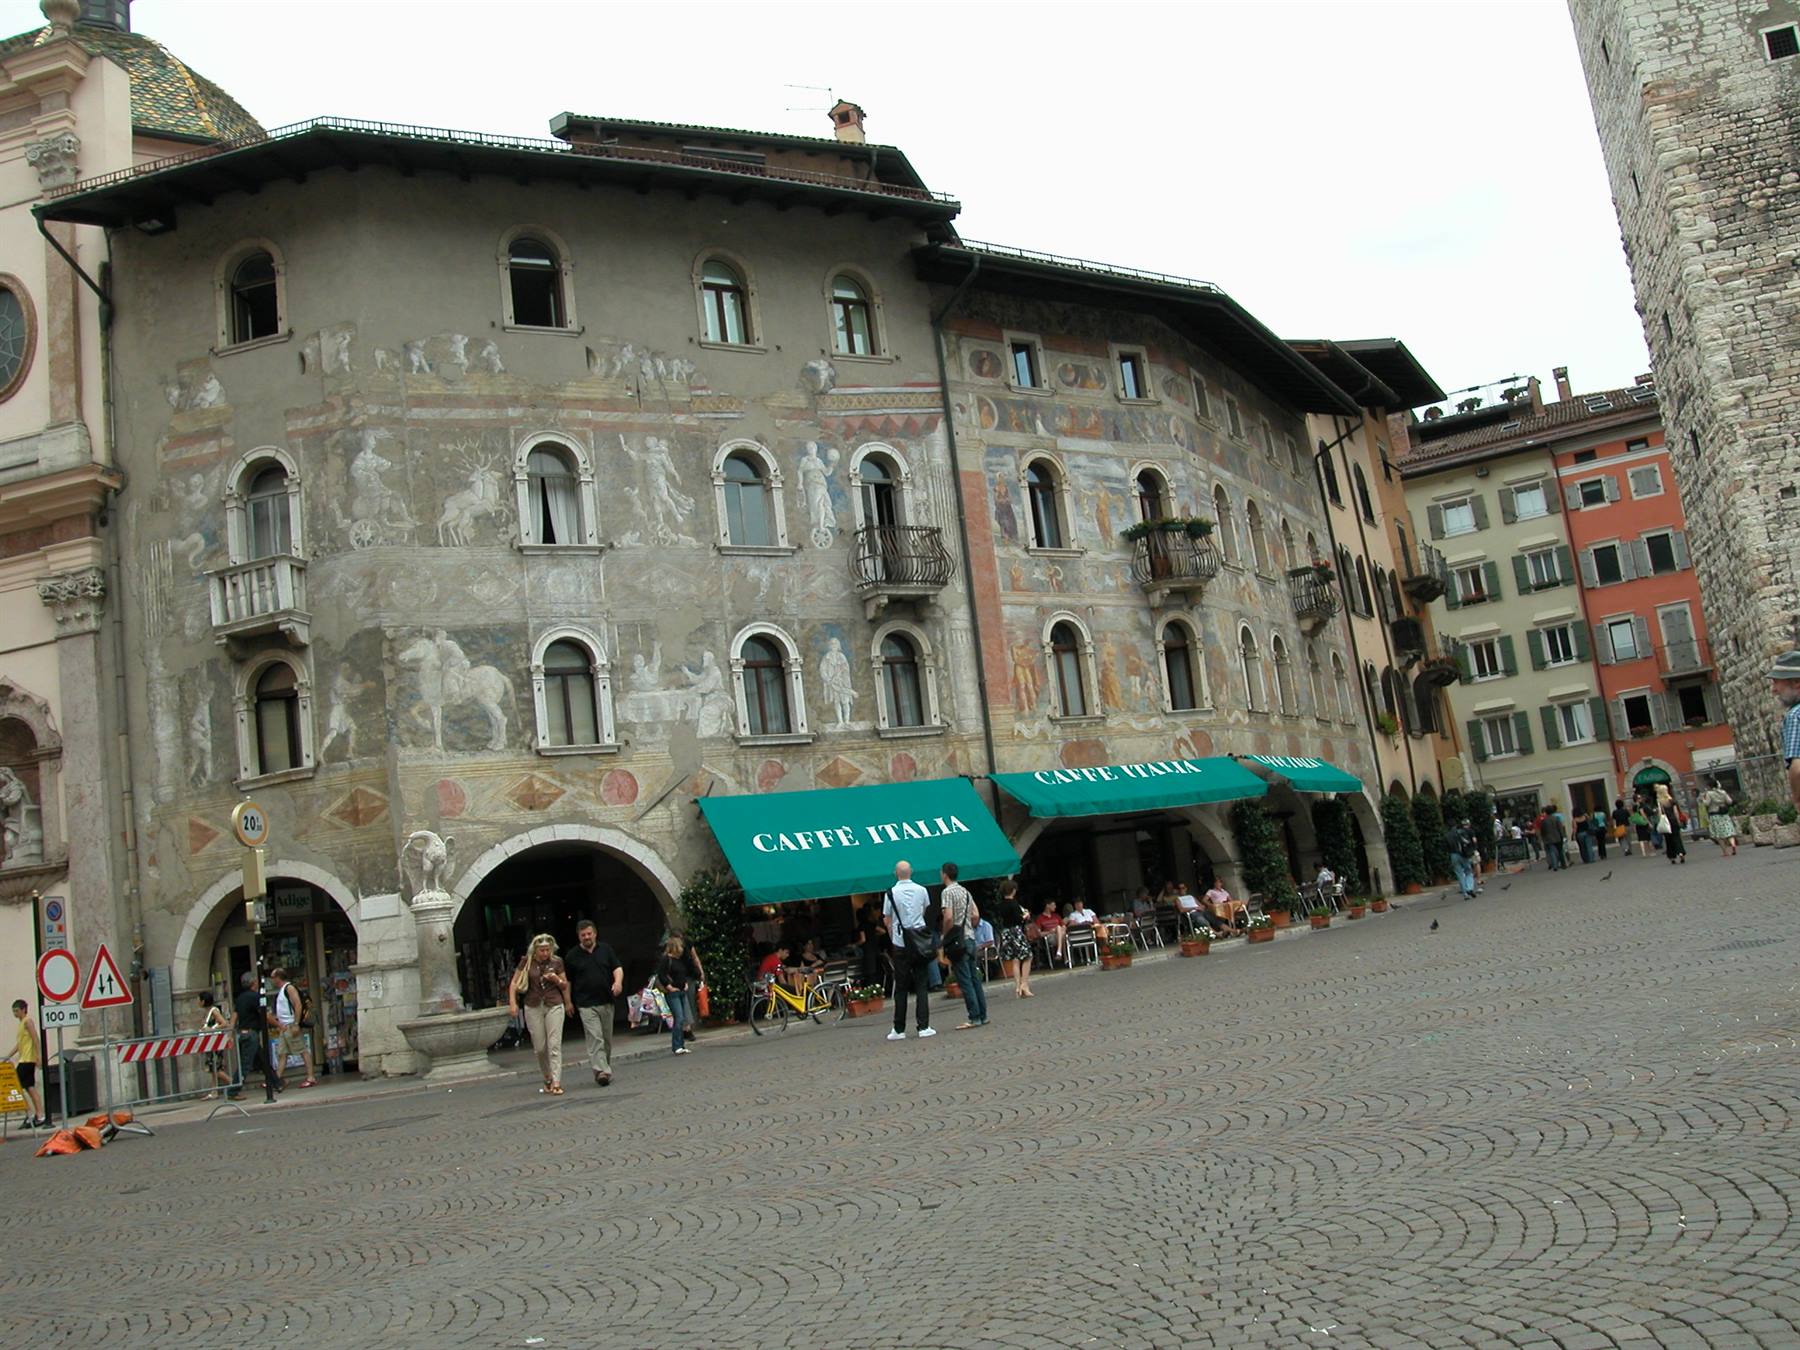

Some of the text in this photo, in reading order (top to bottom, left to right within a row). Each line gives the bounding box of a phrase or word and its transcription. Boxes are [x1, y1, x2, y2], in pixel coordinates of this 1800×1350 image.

[1119, 758, 1202, 779] ITALIA
[243, 815, 256, 831] 20
[752, 815, 970, 852] CAFFÈ ITALIA
[45, 1010, 78, 1022] 100 m
